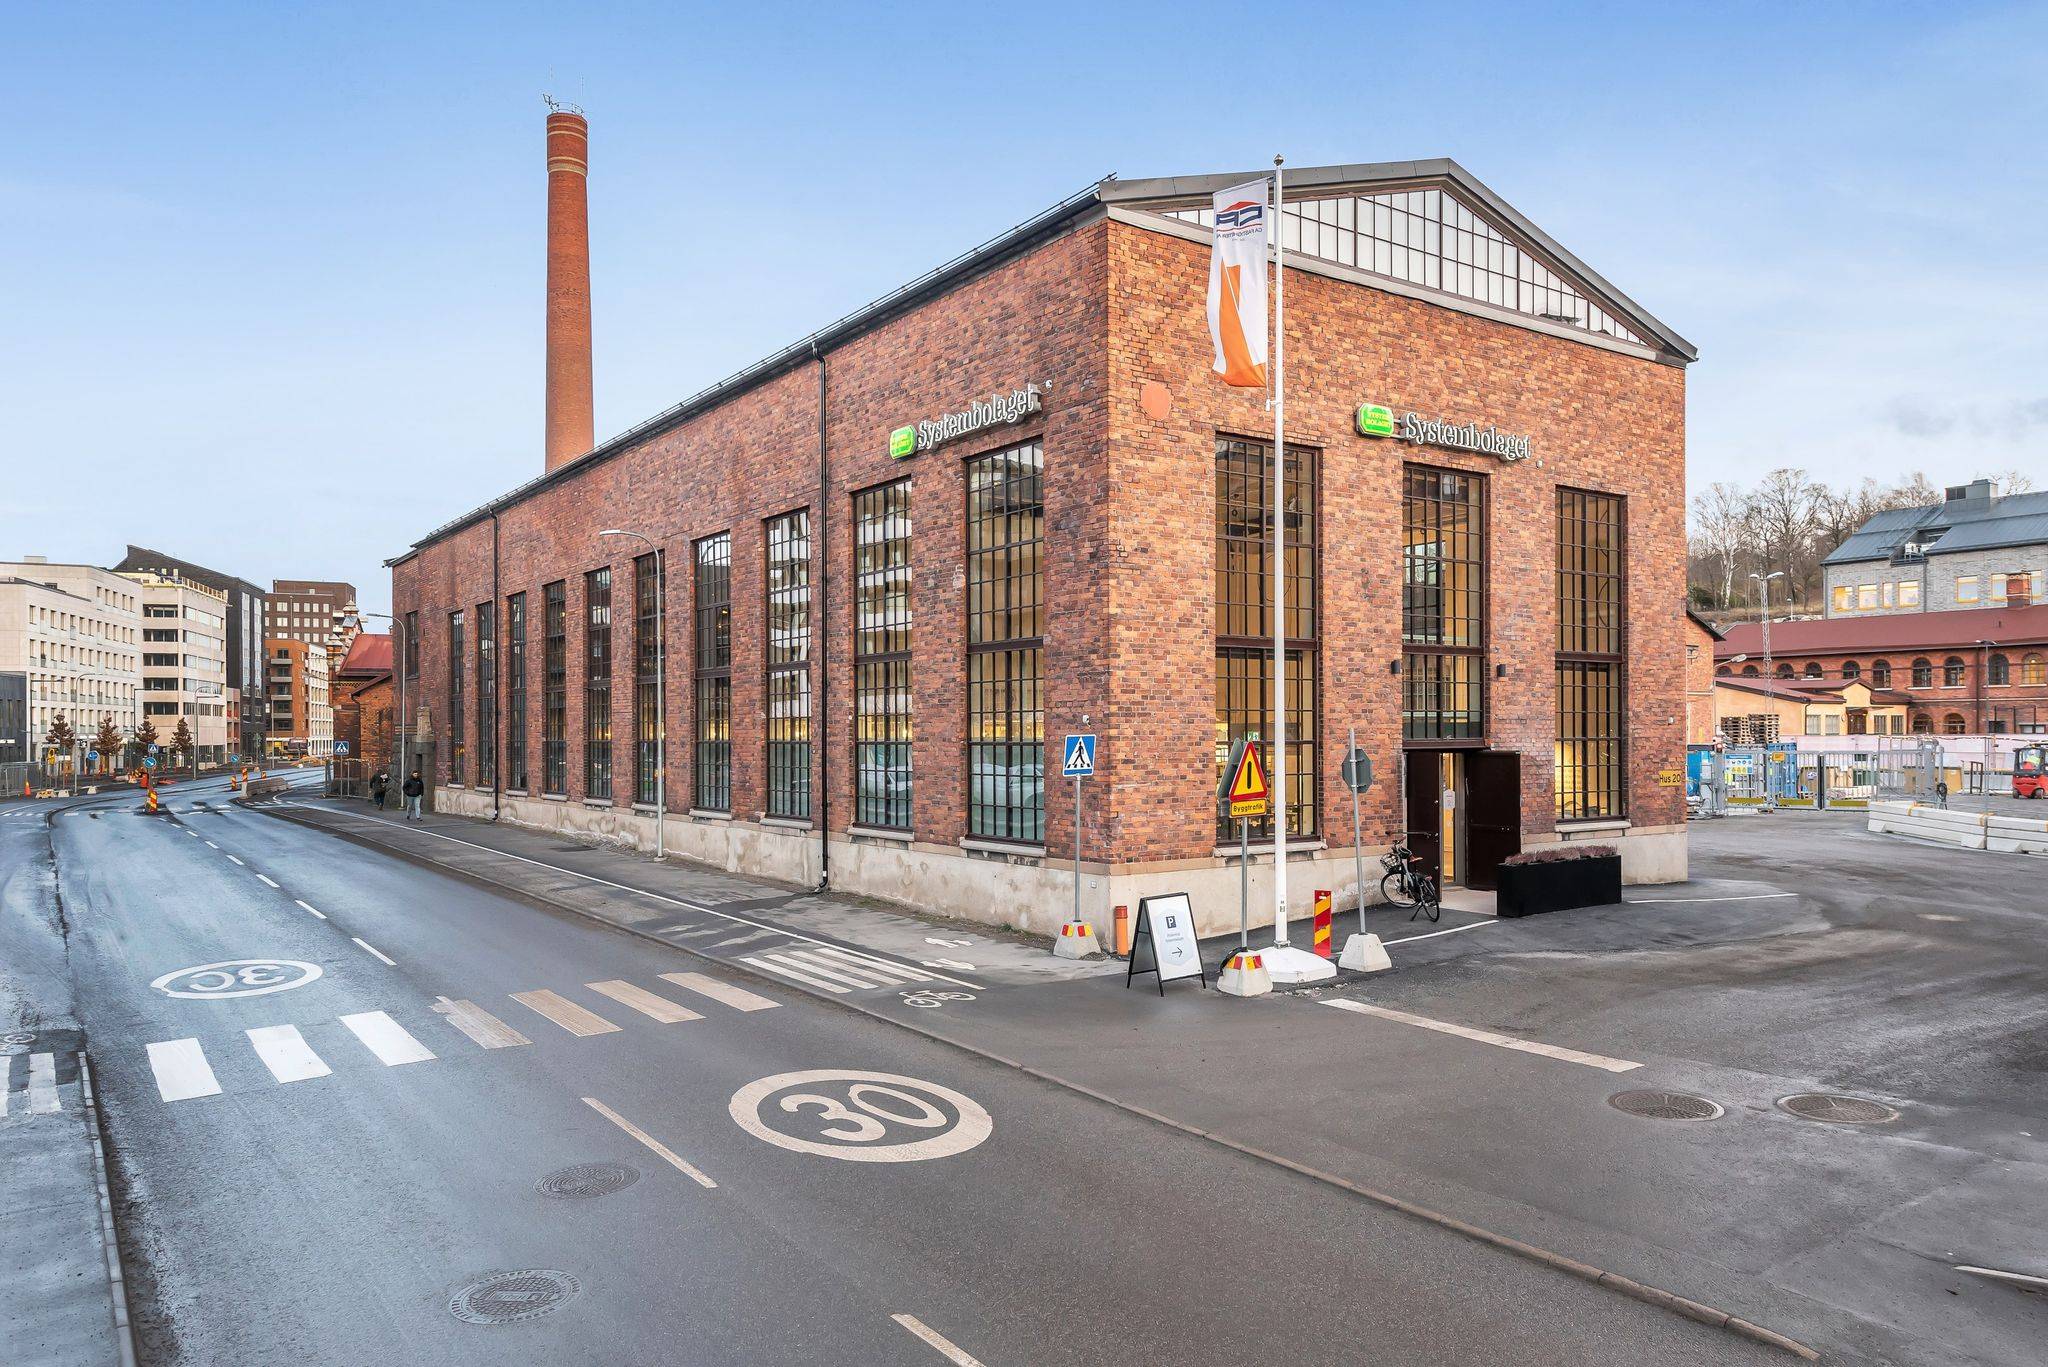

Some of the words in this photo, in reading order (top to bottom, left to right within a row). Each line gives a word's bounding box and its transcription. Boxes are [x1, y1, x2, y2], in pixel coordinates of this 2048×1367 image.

[918, 383, 1036, 450] Systembolaget
[1405, 411, 1532, 461] Systembolaget
[1660, 773, 1671, 783] Hus
[1672, 773, 1681, 783] 20
[1233, 803, 1264, 813] Byggtrafik
[780, 1083, 948, 1142] 30
